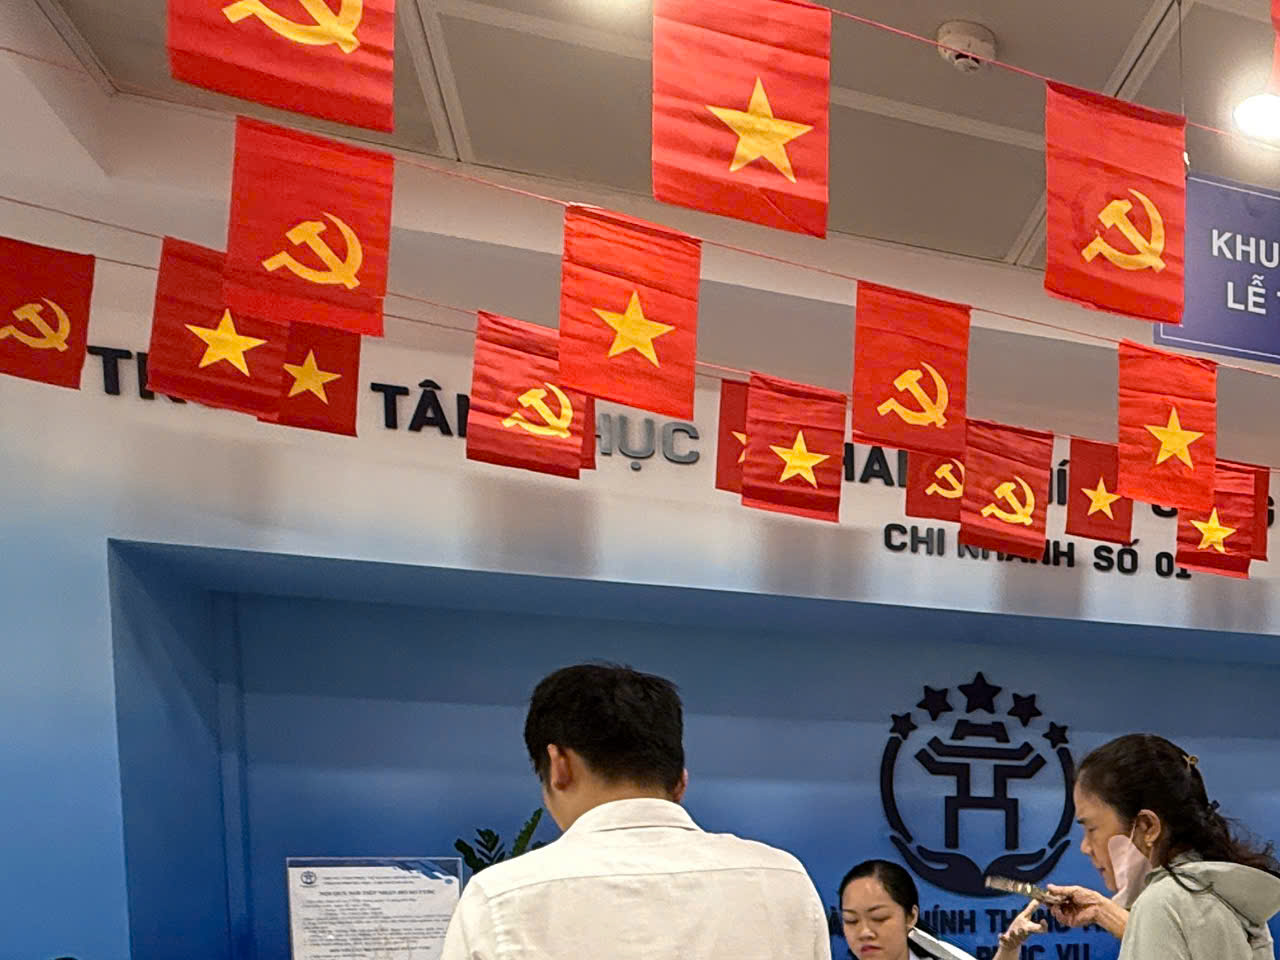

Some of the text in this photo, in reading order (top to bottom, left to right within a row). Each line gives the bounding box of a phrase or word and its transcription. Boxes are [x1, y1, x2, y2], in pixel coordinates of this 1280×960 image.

[1211, 229, 1280, 268] KHU
[1226, 274, 1267, 315] LỄ
[884, 523, 945, 556] CHI
